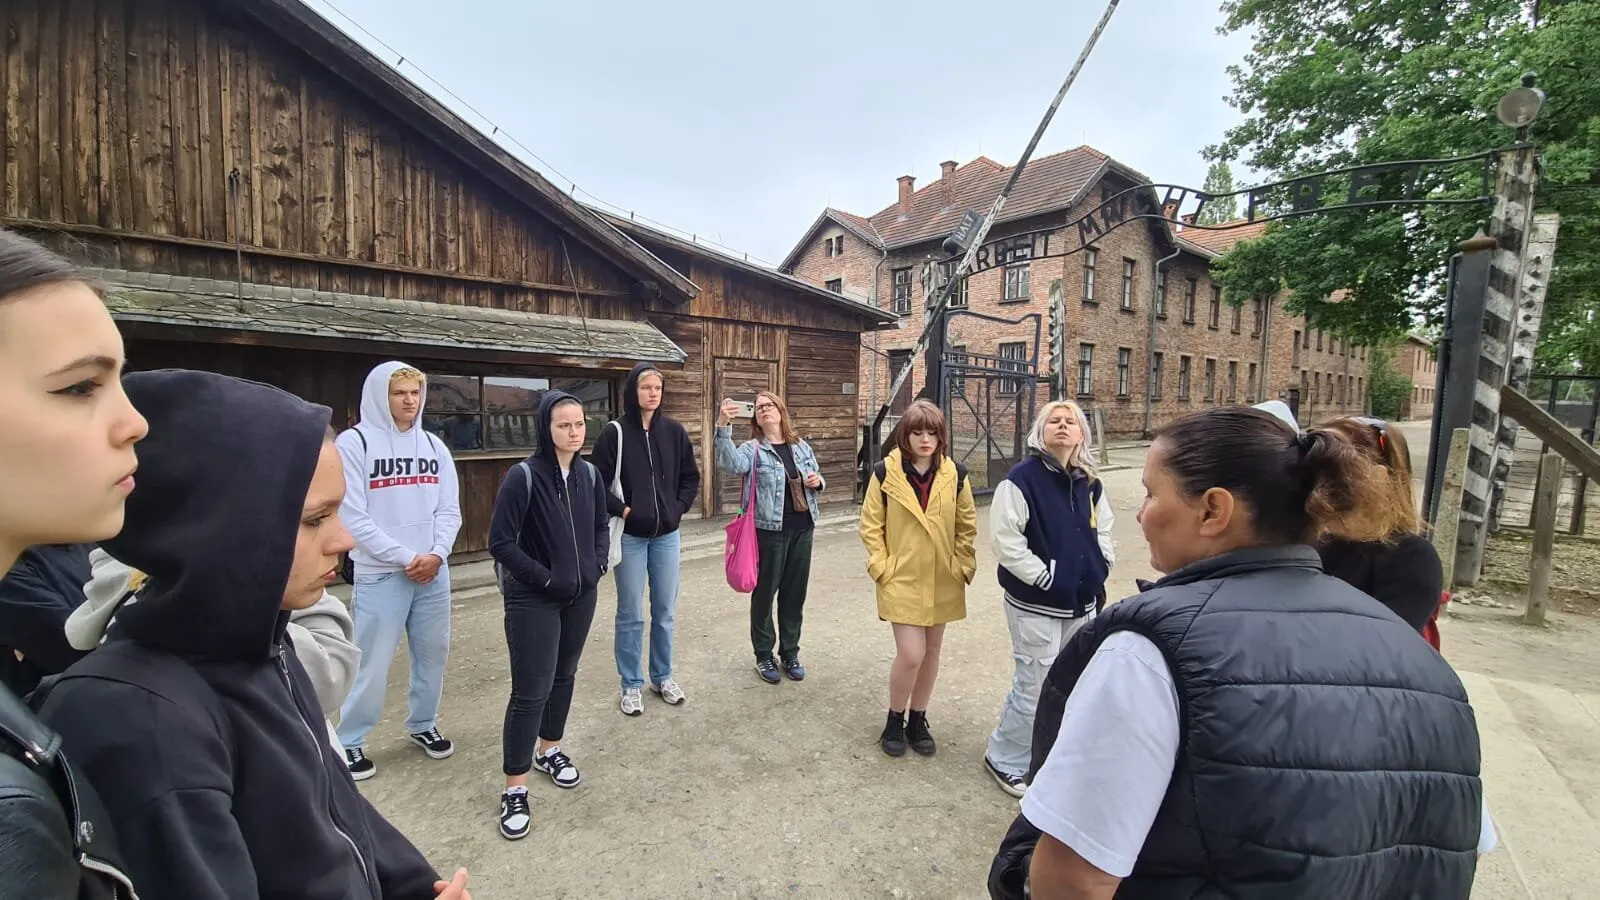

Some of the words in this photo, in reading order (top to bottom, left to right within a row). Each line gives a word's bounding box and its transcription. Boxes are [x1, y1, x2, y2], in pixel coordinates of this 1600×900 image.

[955, 214, 974, 241] HALT
[961, 229, 1056, 276] RBEIT
[369, 458, 413, 479] JUST
[418, 458, 439, 475] DO
